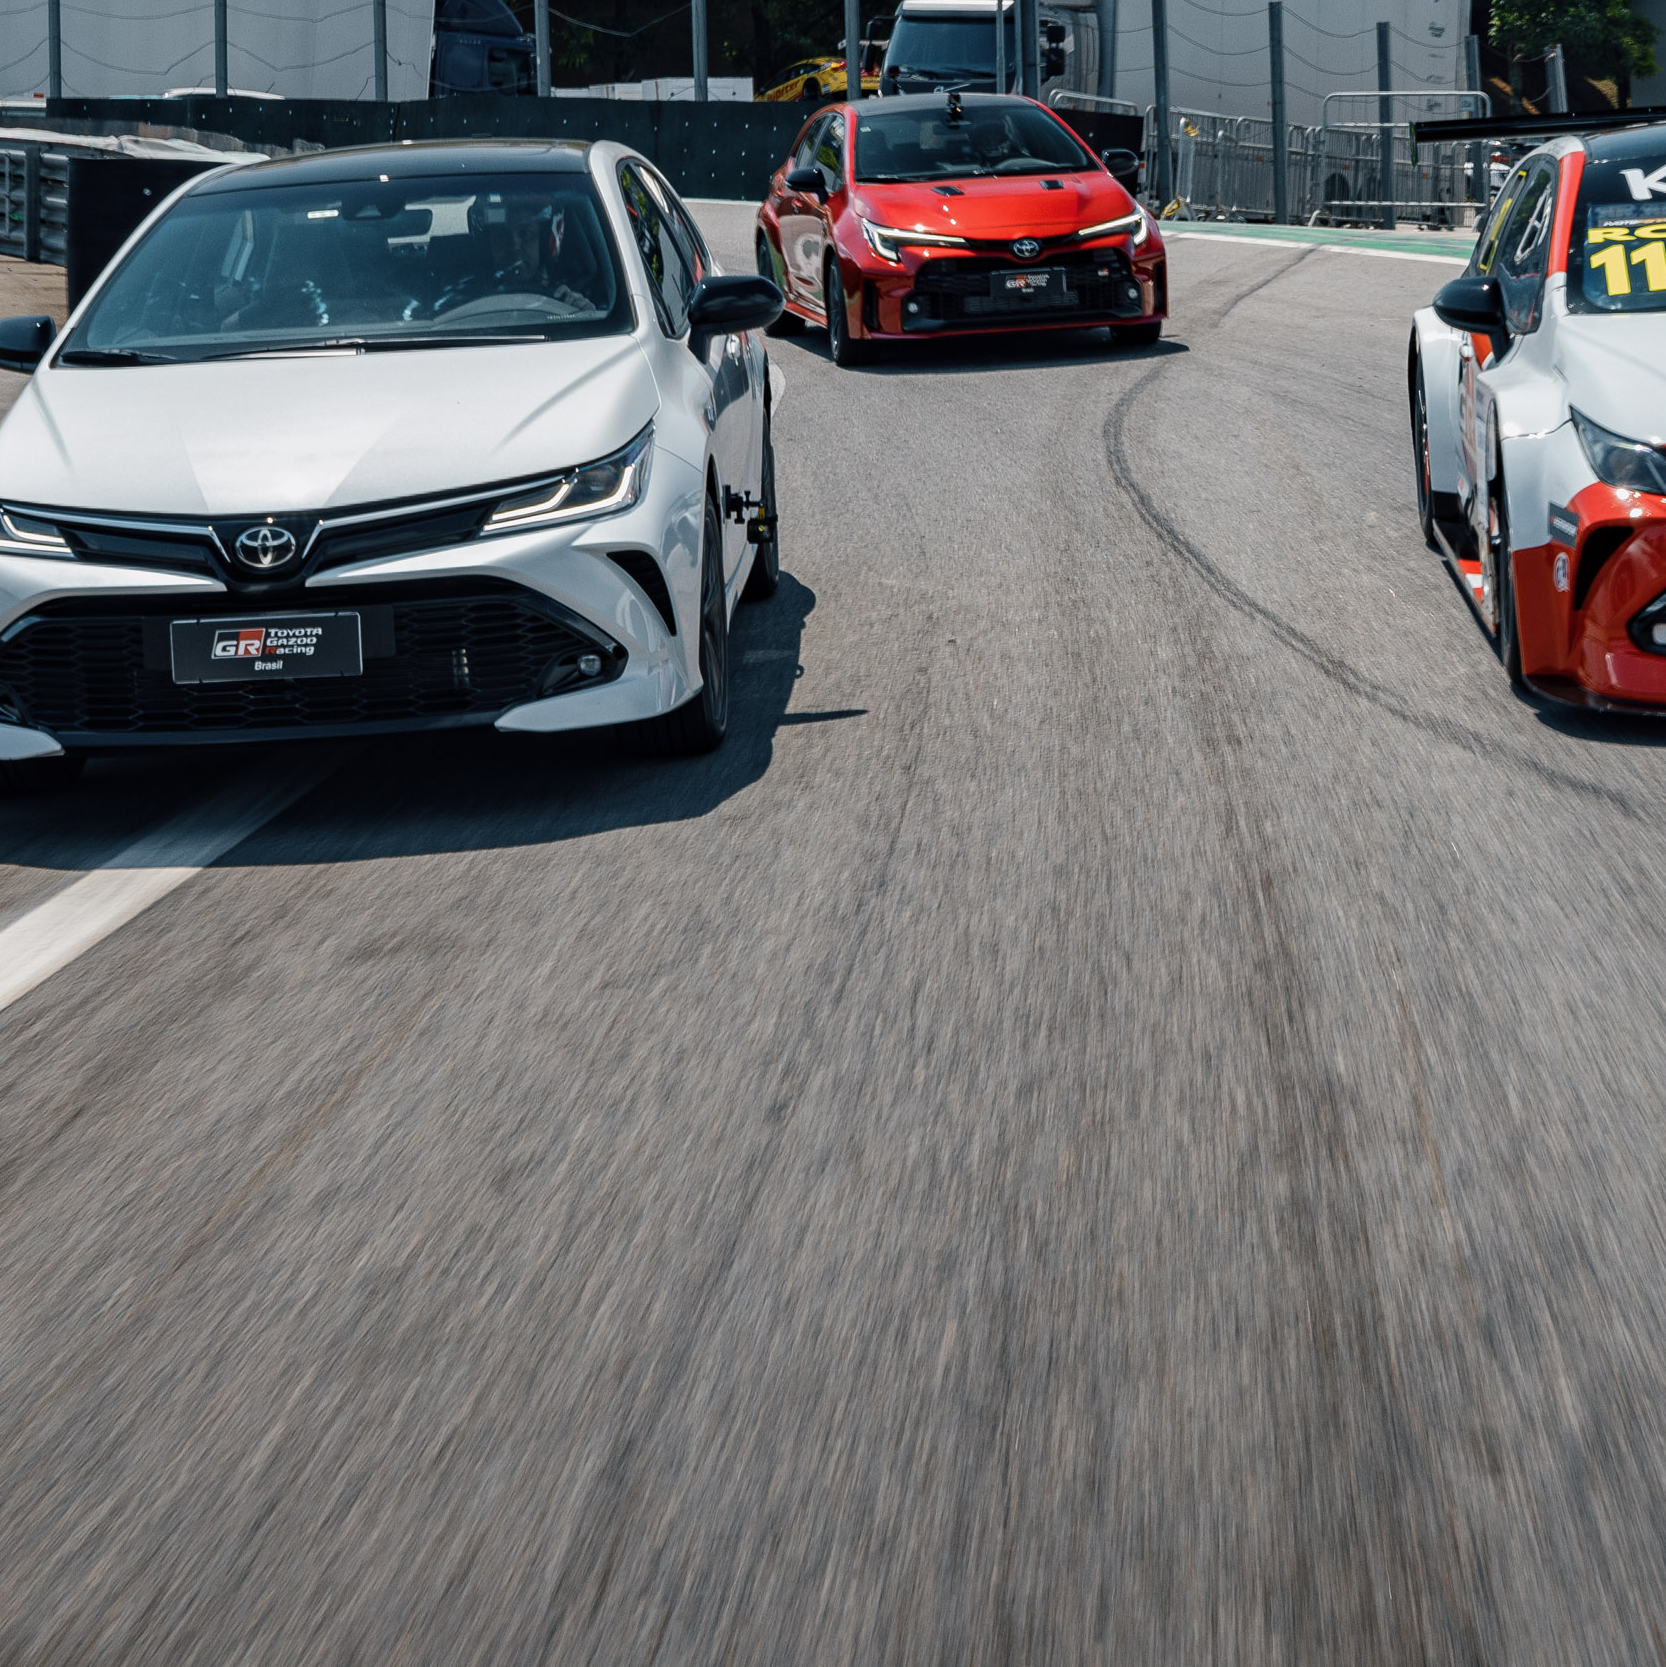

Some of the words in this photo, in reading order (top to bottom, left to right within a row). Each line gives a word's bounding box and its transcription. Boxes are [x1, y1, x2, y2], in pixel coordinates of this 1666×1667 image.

[268, 627, 323, 638] TOYOTA
[266, 636, 317, 647] GAZOO
[214, 639, 261, 658] GR
[265, 645, 315, 656] Racing
[254, 659, 283, 671] Brasil
